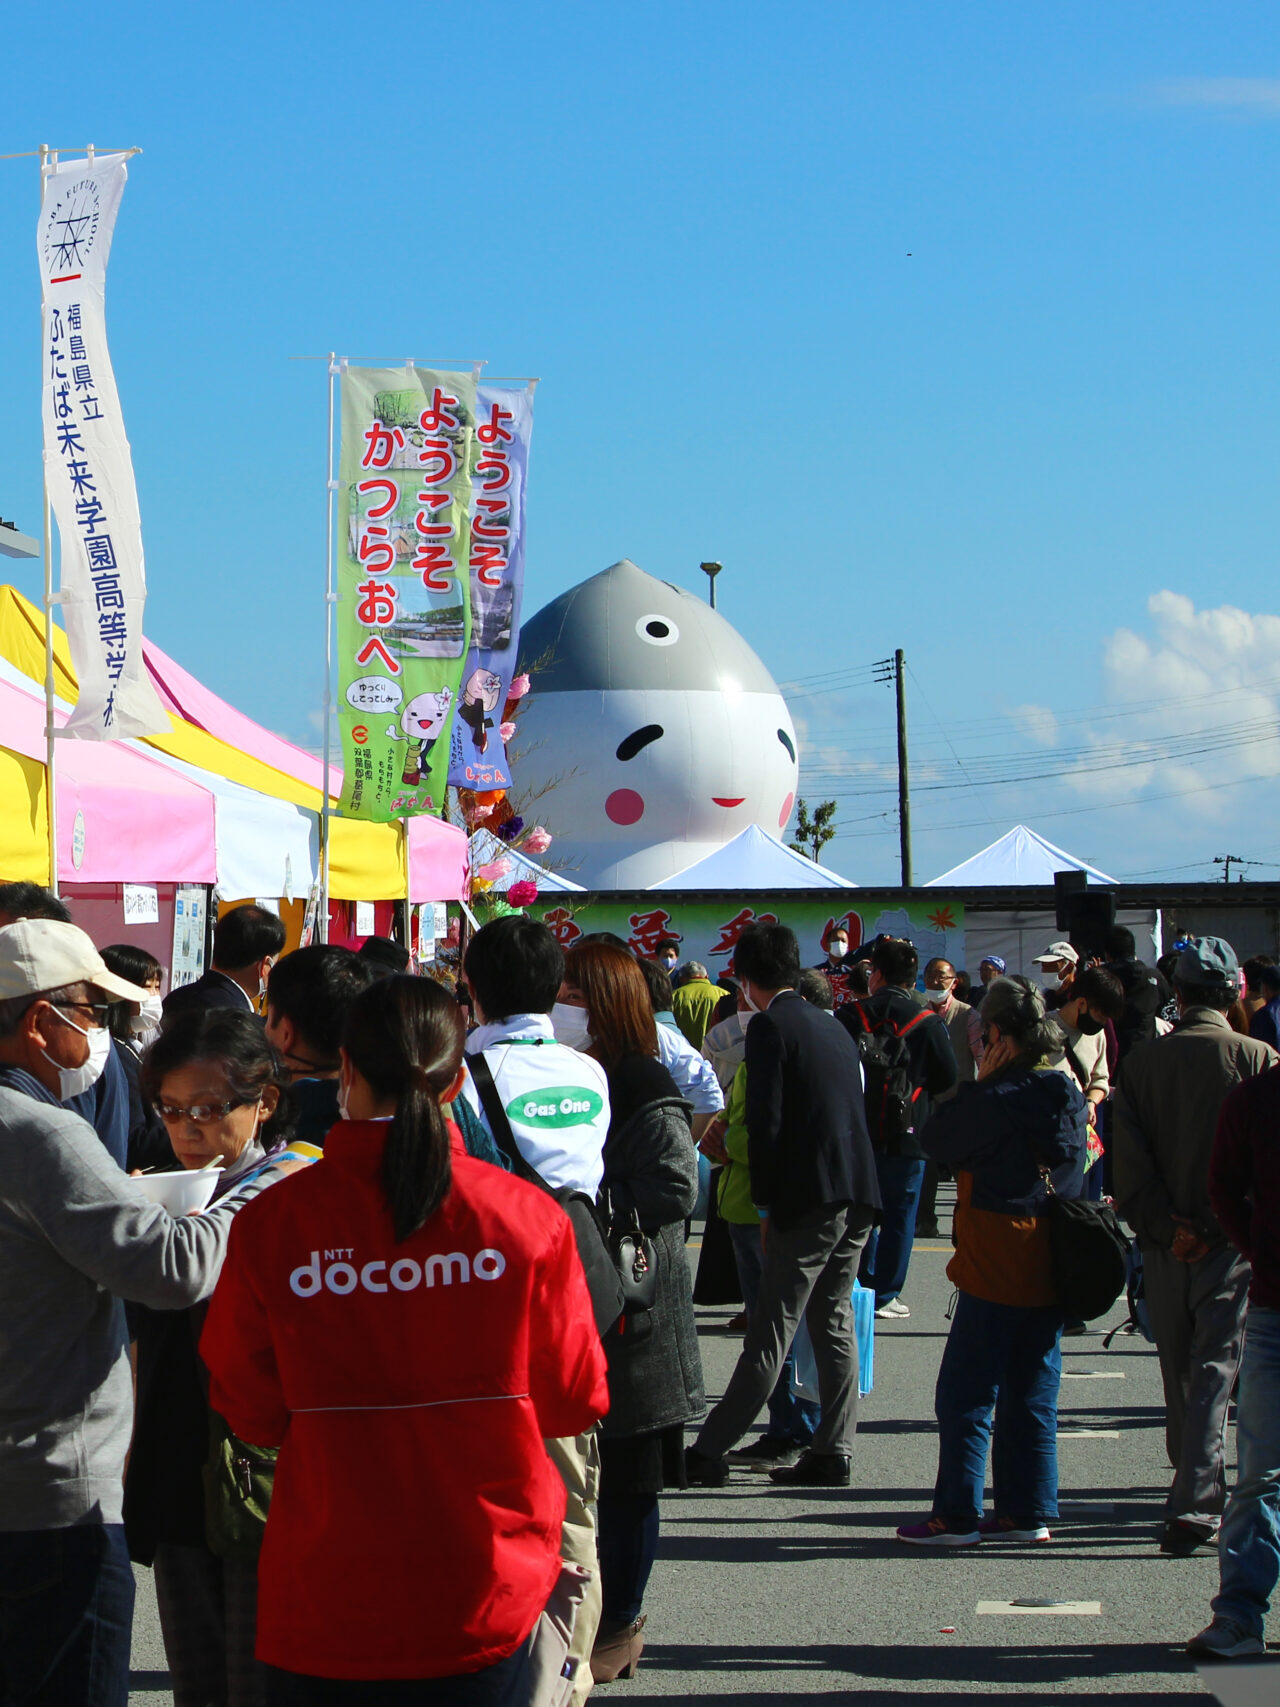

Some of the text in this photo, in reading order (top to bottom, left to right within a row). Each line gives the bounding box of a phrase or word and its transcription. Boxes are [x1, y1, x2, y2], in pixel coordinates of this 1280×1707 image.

[67, 304, 105, 421] 福島県立
[410, 387, 458, 592] ようこそ
[469, 402, 514, 587] ようこそ
[356, 421, 406, 675] かつらおへ
[359, 683, 386, 692] ゆっくり
[523, 1098, 591, 1118] Gas One
[289, 1249, 506, 1298] docomo
[324, 1249, 354, 1260] NTT
